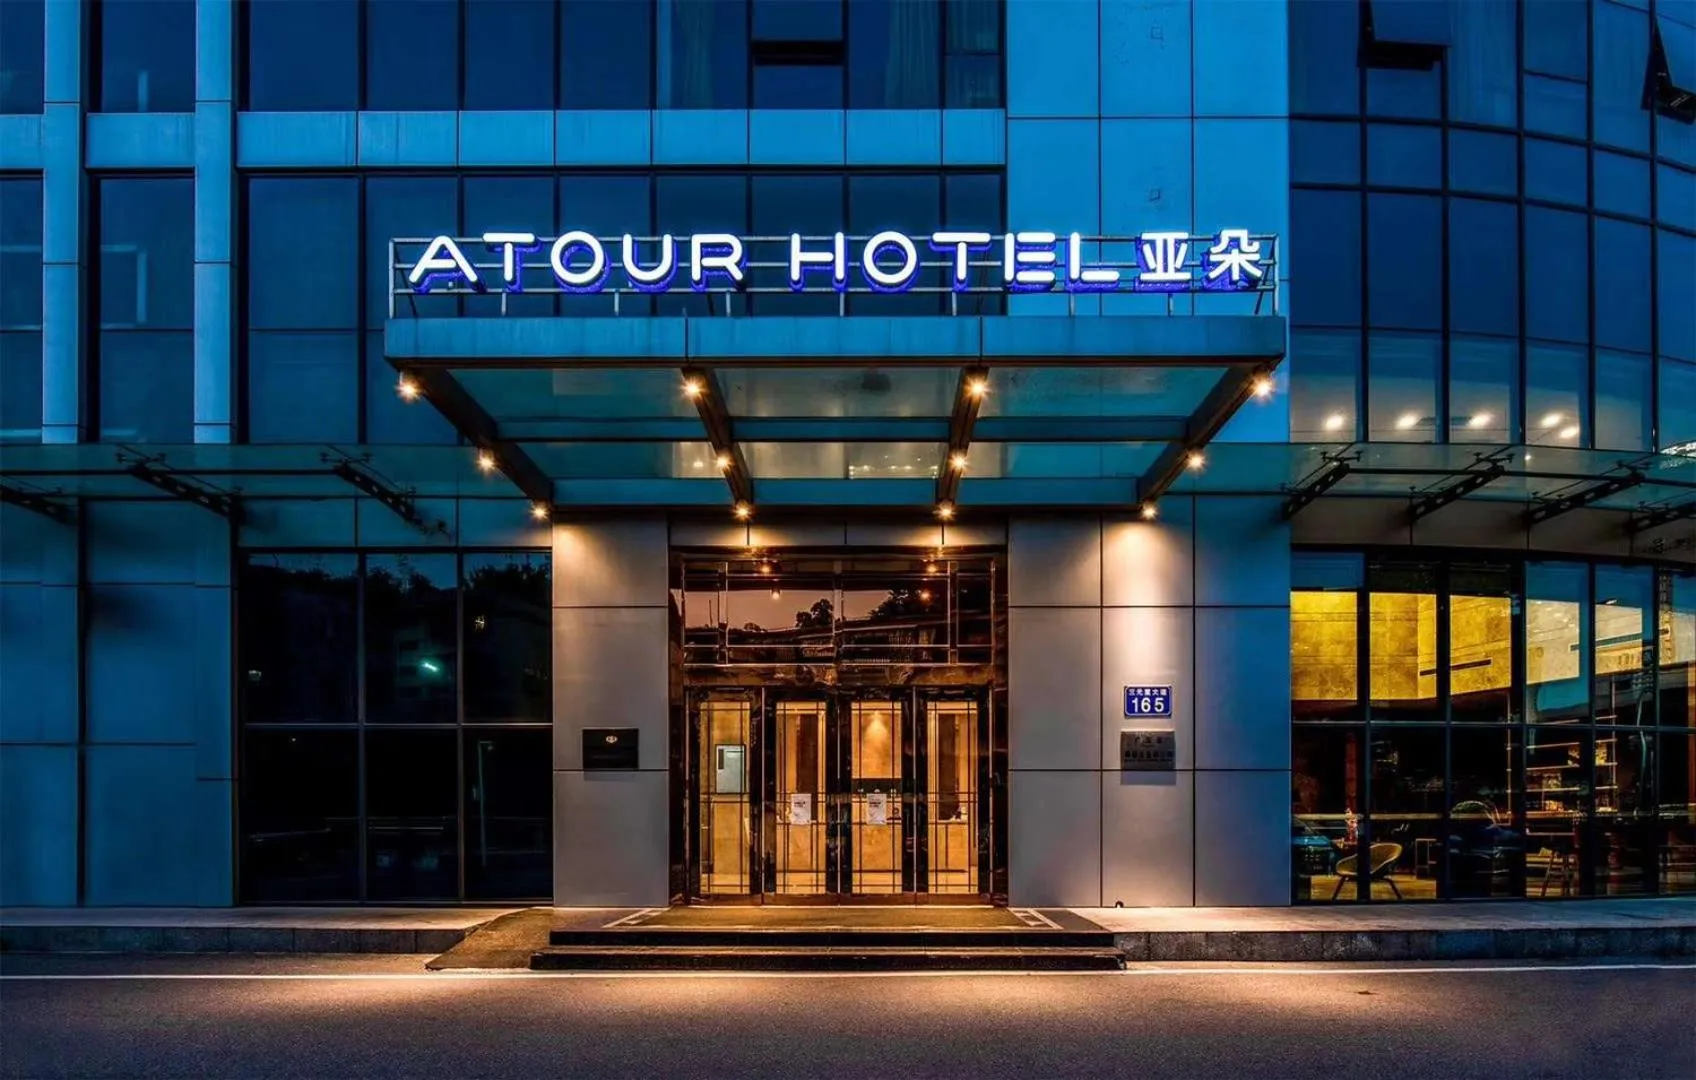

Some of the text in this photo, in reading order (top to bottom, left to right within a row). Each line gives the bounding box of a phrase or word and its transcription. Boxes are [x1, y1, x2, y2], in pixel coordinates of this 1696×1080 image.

[408, 229, 1262, 284] ATOUR HOTEL 亚朵
[1132, 697, 1164, 712] 165
